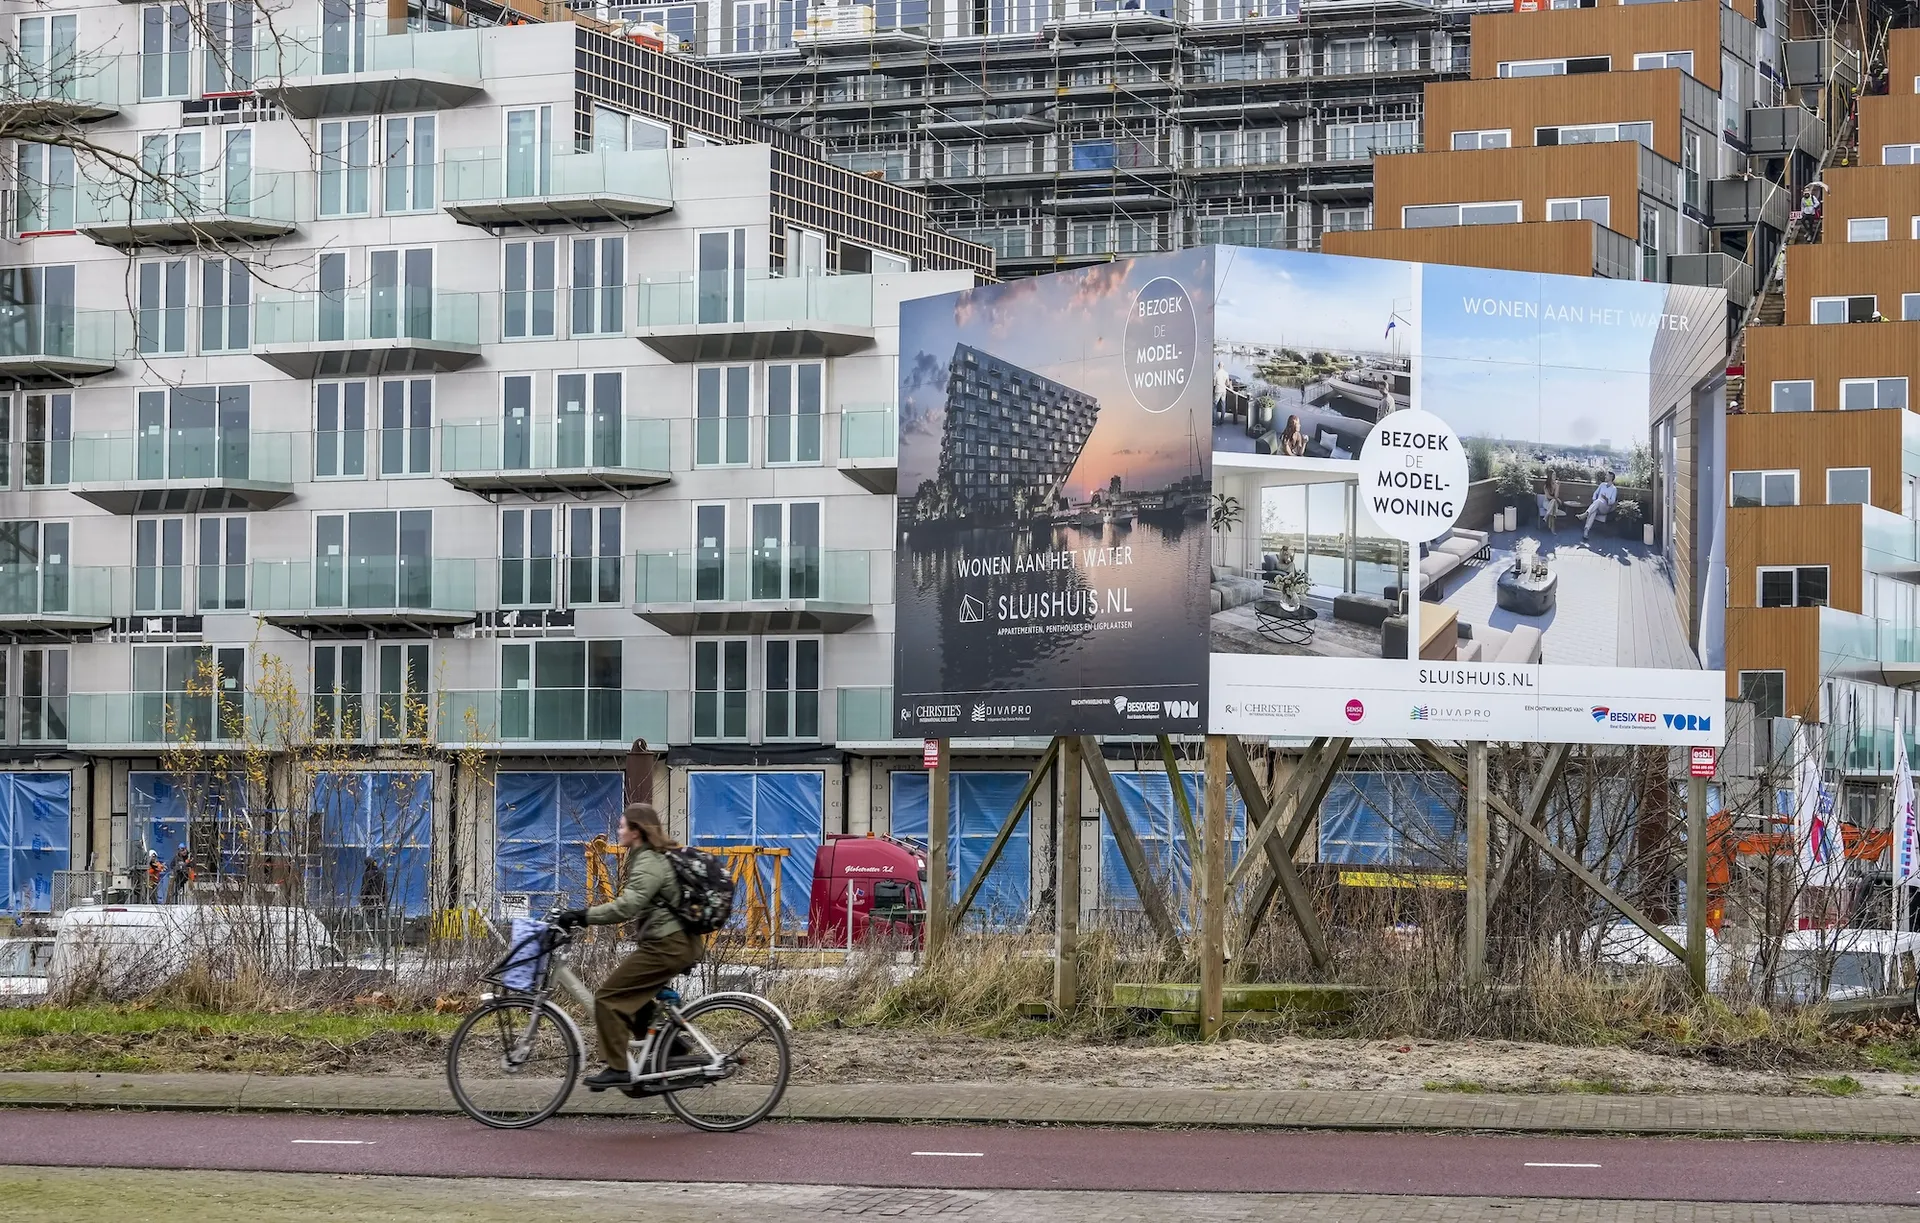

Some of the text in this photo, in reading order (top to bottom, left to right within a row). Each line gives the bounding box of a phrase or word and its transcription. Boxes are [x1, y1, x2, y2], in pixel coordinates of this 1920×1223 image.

[1139, 296, 1182, 317] BEZOEK
[1462, 297, 1690, 331] WONEN AAN HET WATER
[1153, 325, 1166, 338] DE
[1136, 344, 1182, 364] MODEL-
[1134, 368, 1184, 388] WONING
[1381, 431, 1448, 451] BEZOEK
[1405, 454, 1424, 468] DE
[1377, 470, 1450, 491] MODEL-
[1373, 497, 1453, 518] WONING
[957, 546, 1133, 578] WONEN AAN HET WATER
[997, 587, 1133, 621] SLUISHUIS.NL
[997, 620, 1133, 636] APPARTEMENTEN, PENTHOUSES EN LIGPLAATSEN
[1419, 669, 1534, 687] SLUISHUIS.NL
[916, 704, 962, 718] CHRISTIE'S
[986, 705, 1032, 715] DIVAPRO
[1163, 700, 1199, 718] VORM
[1244, 703, 1301, 714] CHRISTIE'S
[1430, 708, 1491, 718] DIVAPRO
[1662, 713, 1711, 731] VORM
[845, 865, 894, 873] Globetrotter XL
